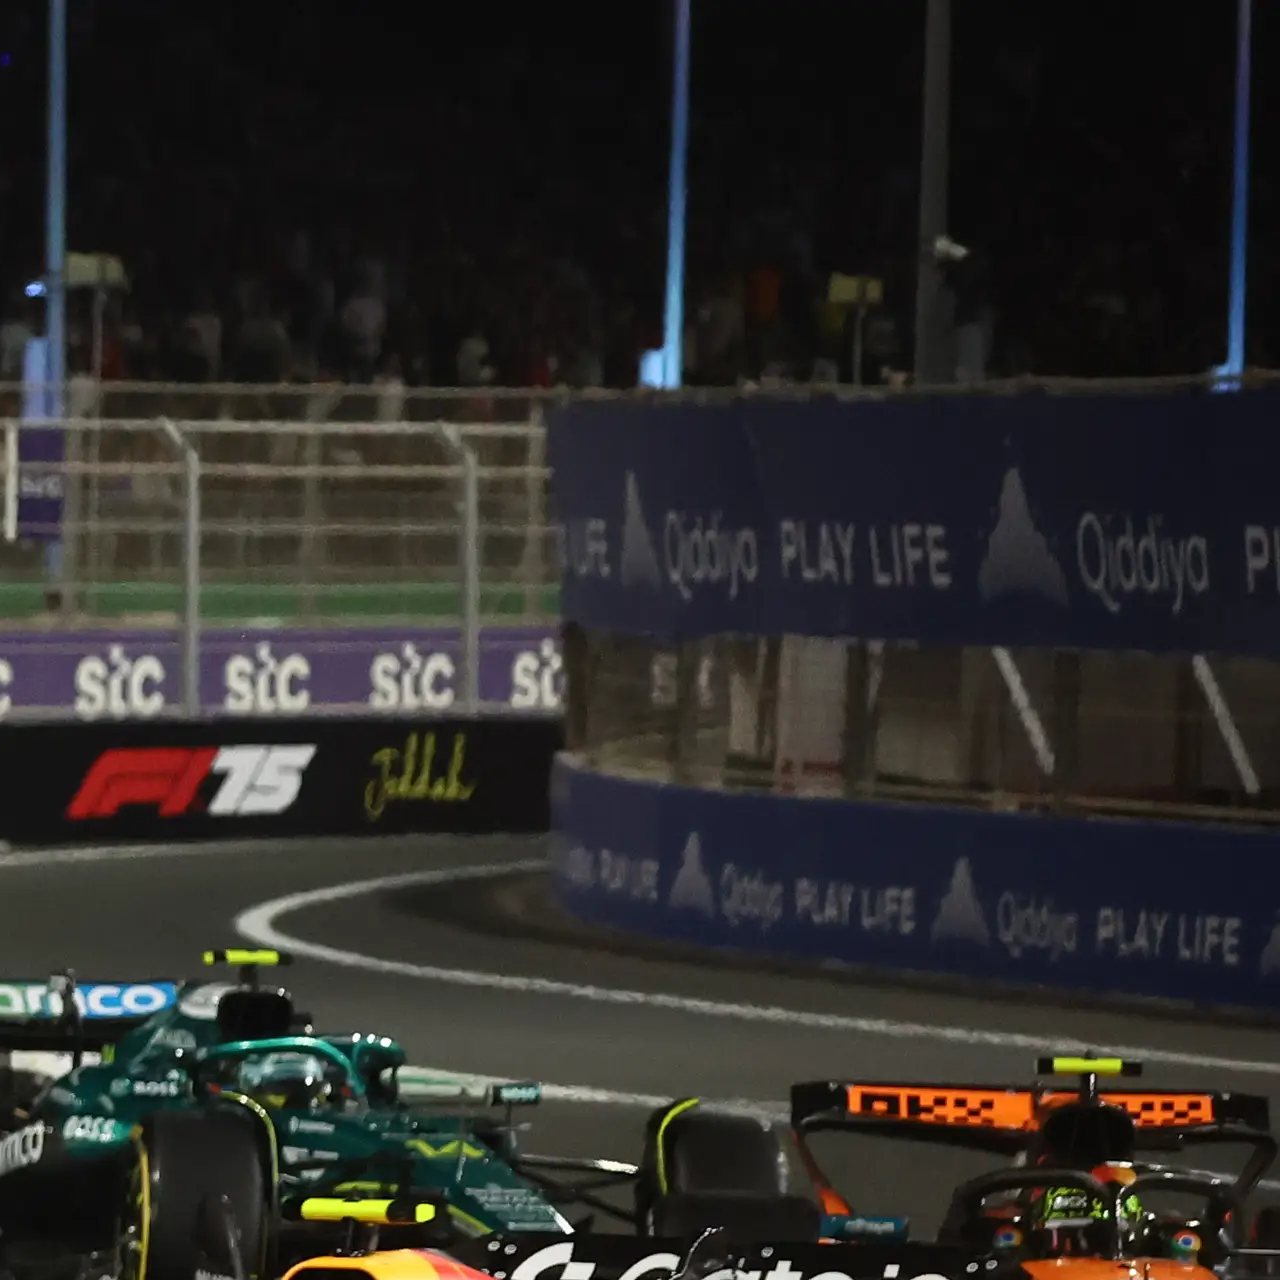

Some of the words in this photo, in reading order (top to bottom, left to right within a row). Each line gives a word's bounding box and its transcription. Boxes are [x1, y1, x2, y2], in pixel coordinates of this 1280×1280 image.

[780, 519, 856, 586] PLAY
[869, 522, 952, 589] LIFE
[1076, 510, 1210, 617] Qiddiya
[74, 644, 166, 717] stc
[224, 641, 312, 713] stc
[370, 640, 455, 710] stc
[511, 638, 564, 708] st
[207, 743, 317, 816] 75
[1096, 904, 1169, 958] PLAY
[1176, 911, 1242, 966] LIFE
